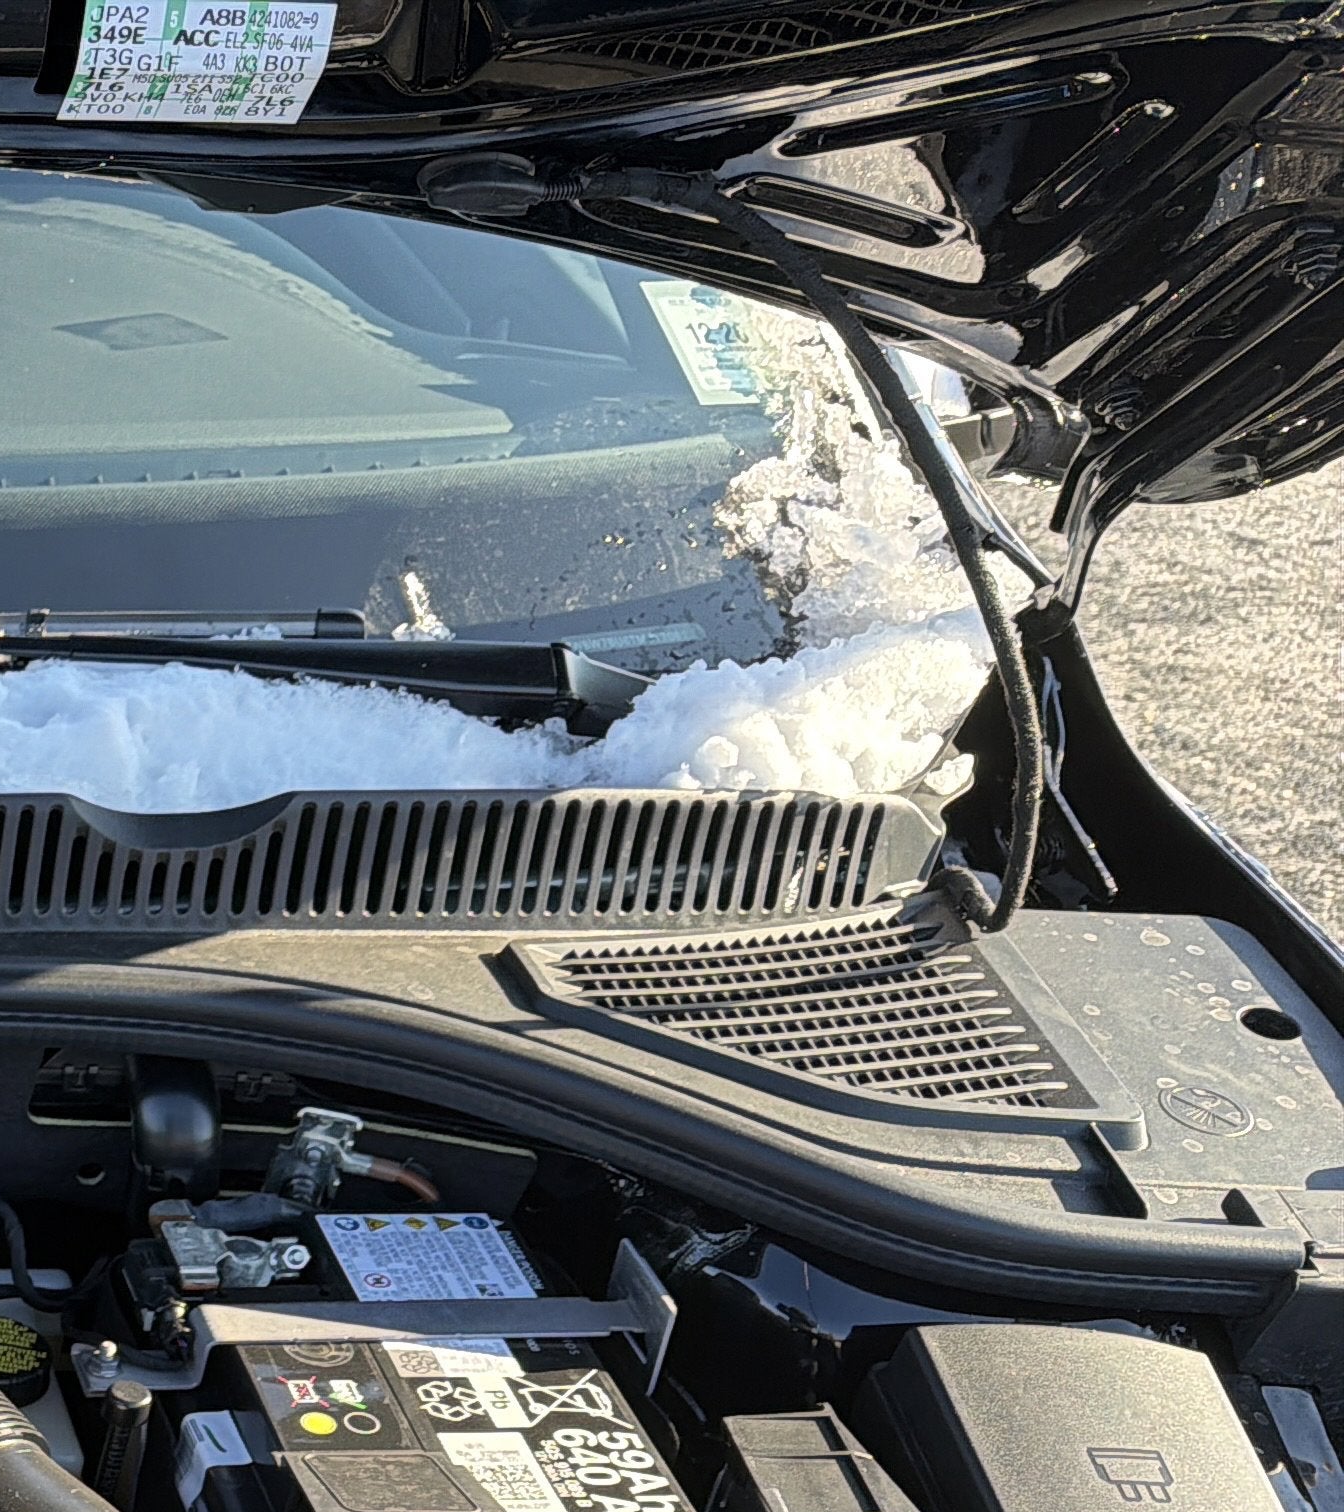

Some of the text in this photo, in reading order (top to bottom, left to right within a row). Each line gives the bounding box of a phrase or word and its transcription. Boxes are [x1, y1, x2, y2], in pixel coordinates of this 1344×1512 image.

[87, 25, 148, 45] 349E
[173, 29, 221, 47] ACC
[553, 1427, 622, 1486] 640
